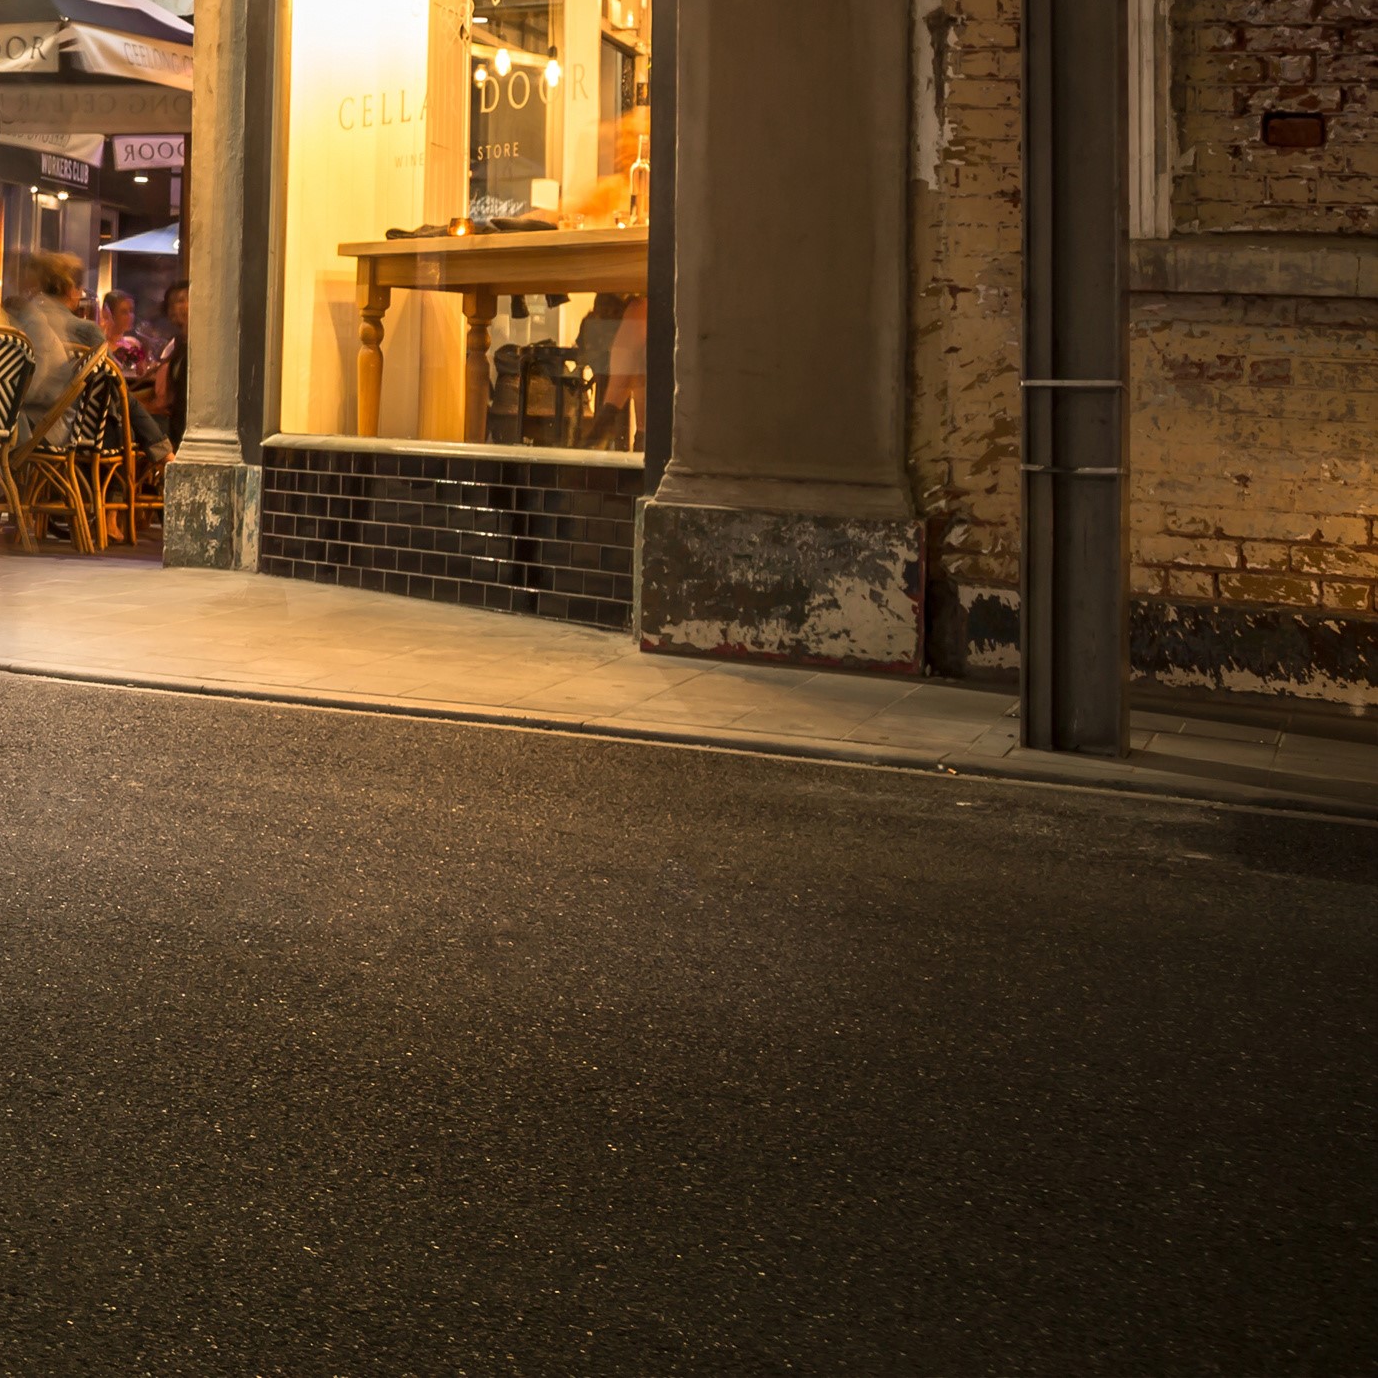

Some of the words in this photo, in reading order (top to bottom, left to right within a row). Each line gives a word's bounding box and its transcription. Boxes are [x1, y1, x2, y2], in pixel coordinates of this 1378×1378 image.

[338, 87, 437, 131] CELLA
[477, 141, 520, 161] STORE
[41, 152, 73, 180] WORKERS
[72, 160, 89, 184] CLUB
